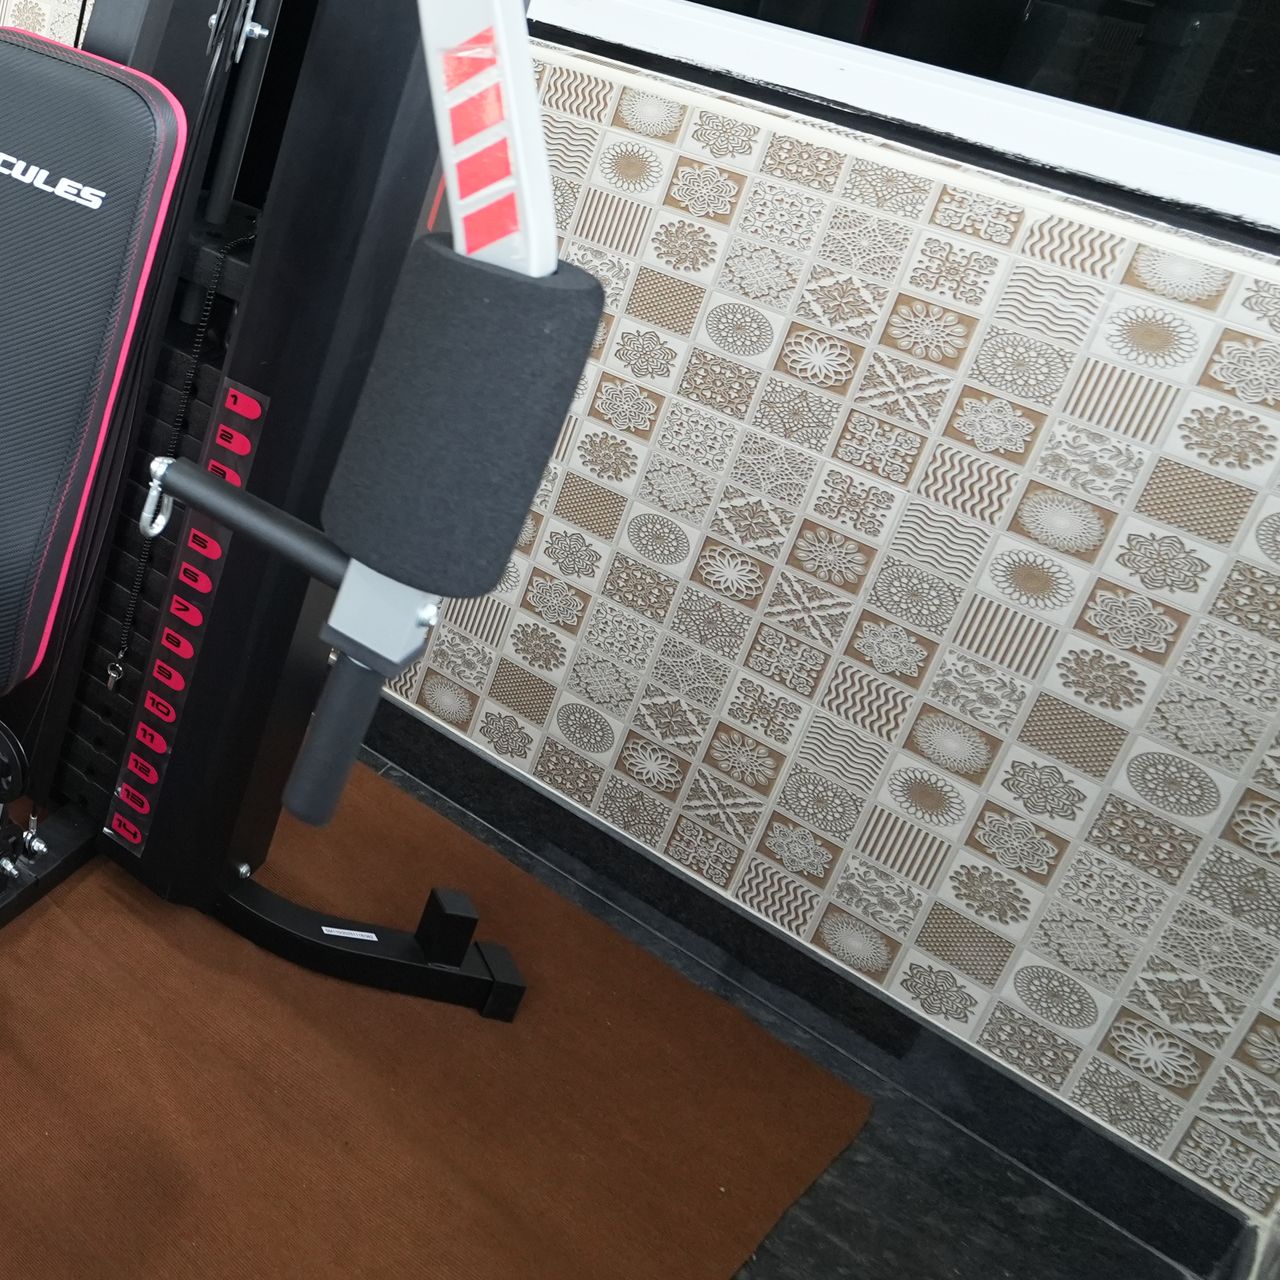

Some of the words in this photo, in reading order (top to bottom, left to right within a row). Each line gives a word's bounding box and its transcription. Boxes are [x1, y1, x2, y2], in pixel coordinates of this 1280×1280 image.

[230, 394, 238, 406] 1
[219, 429, 234, 444] 2
[210, 463, 227, 480] 3
[191, 533, 209, 550] 5
[182, 567, 200, 584] 6
[175, 601, 191, 613] 7
[165, 632, 182, 649] 8
[156, 664, 173, 680] 9
[149, 697, 171, 717] 10
[140, 727, 155, 744] 11
[132, 757, 151, 777] 12
[124, 788, 145, 809] 13
[116, 817, 139, 840] 14
